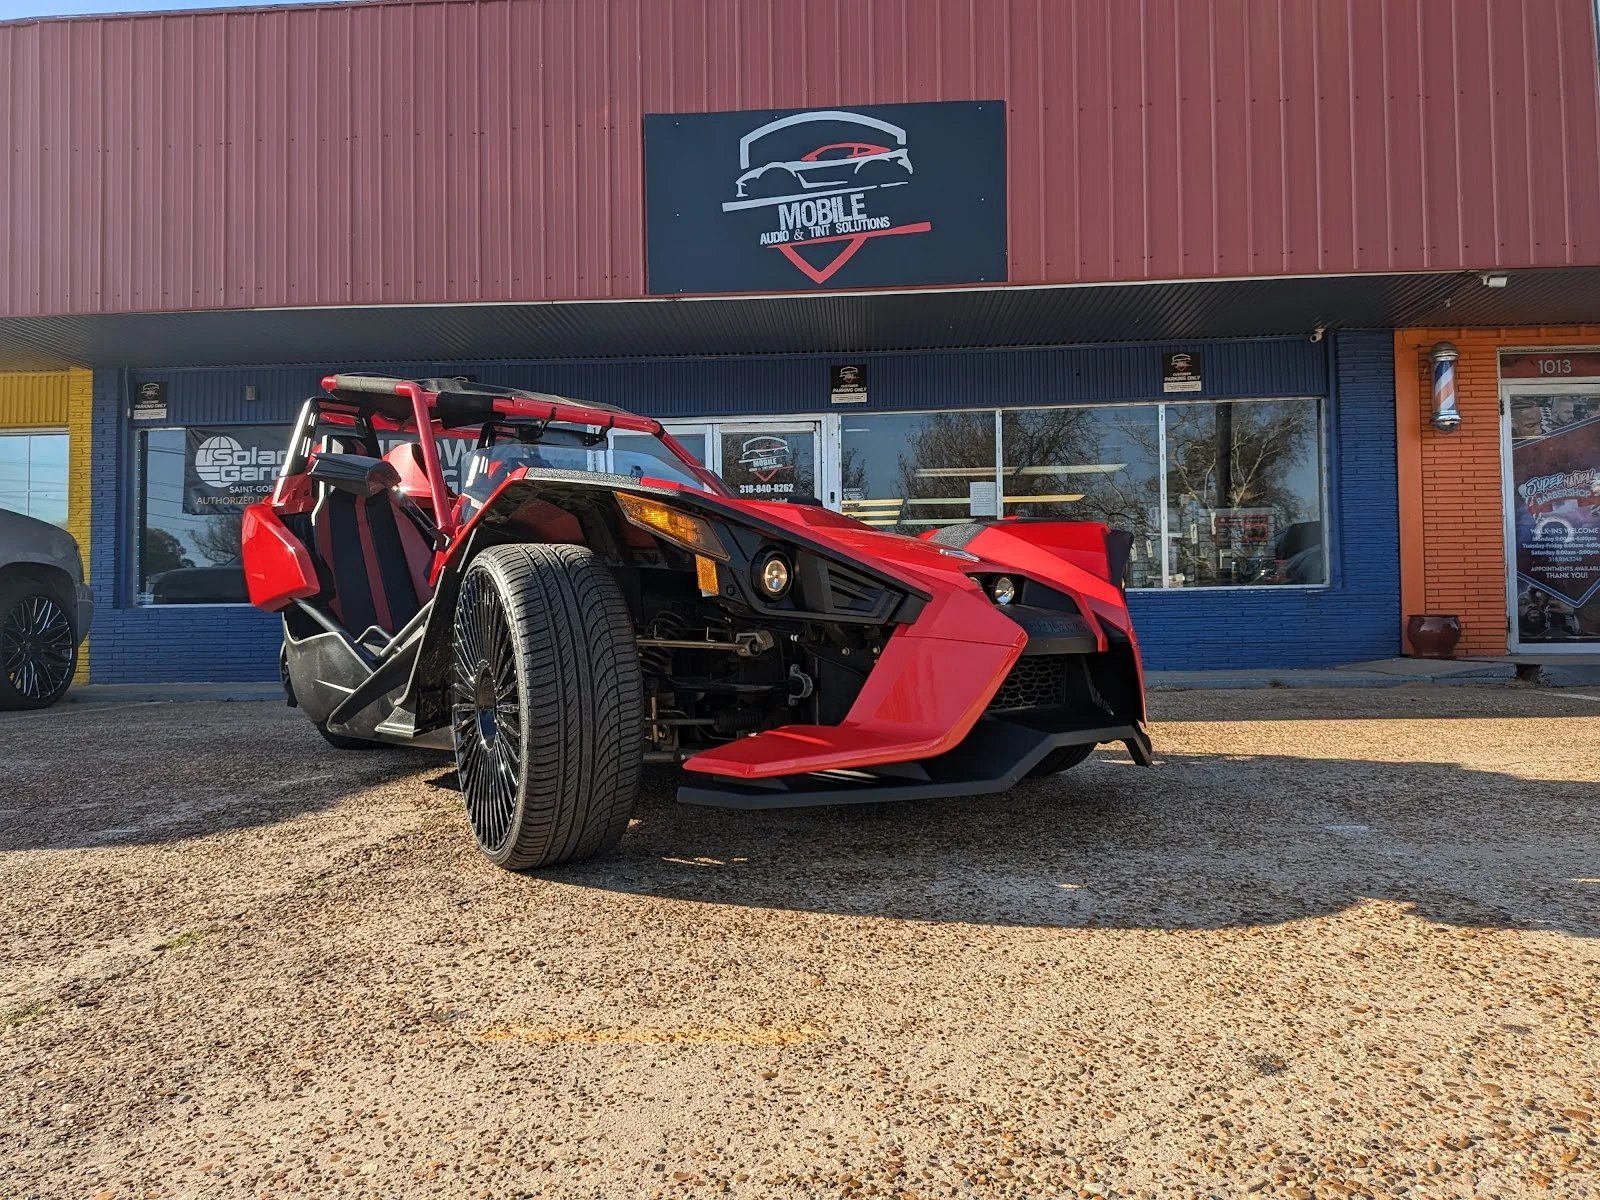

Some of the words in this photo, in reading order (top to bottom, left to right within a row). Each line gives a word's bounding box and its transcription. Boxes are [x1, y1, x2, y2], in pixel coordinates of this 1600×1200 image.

[778, 193, 867, 230] MOBILE
[760, 229, 789, 246] AUDIO
[793, 229, 804, 241] &
[810, 224, 831, 239] TINT
[836, 216, 890, 234] SOLUTIONS
[1538, 359, 1572, 374] 1013
[213, 447, 288, 466] Solar
[753, 458, 777, 468] MOBILE
[229, 485, 275, 494] SAINT-GOB
[740, 484, 794, 493] 318-840-8262
[196, 496, 255, 505] AUTHORIZED
[1536, 489, 1592, 506] BARBERSHOP
